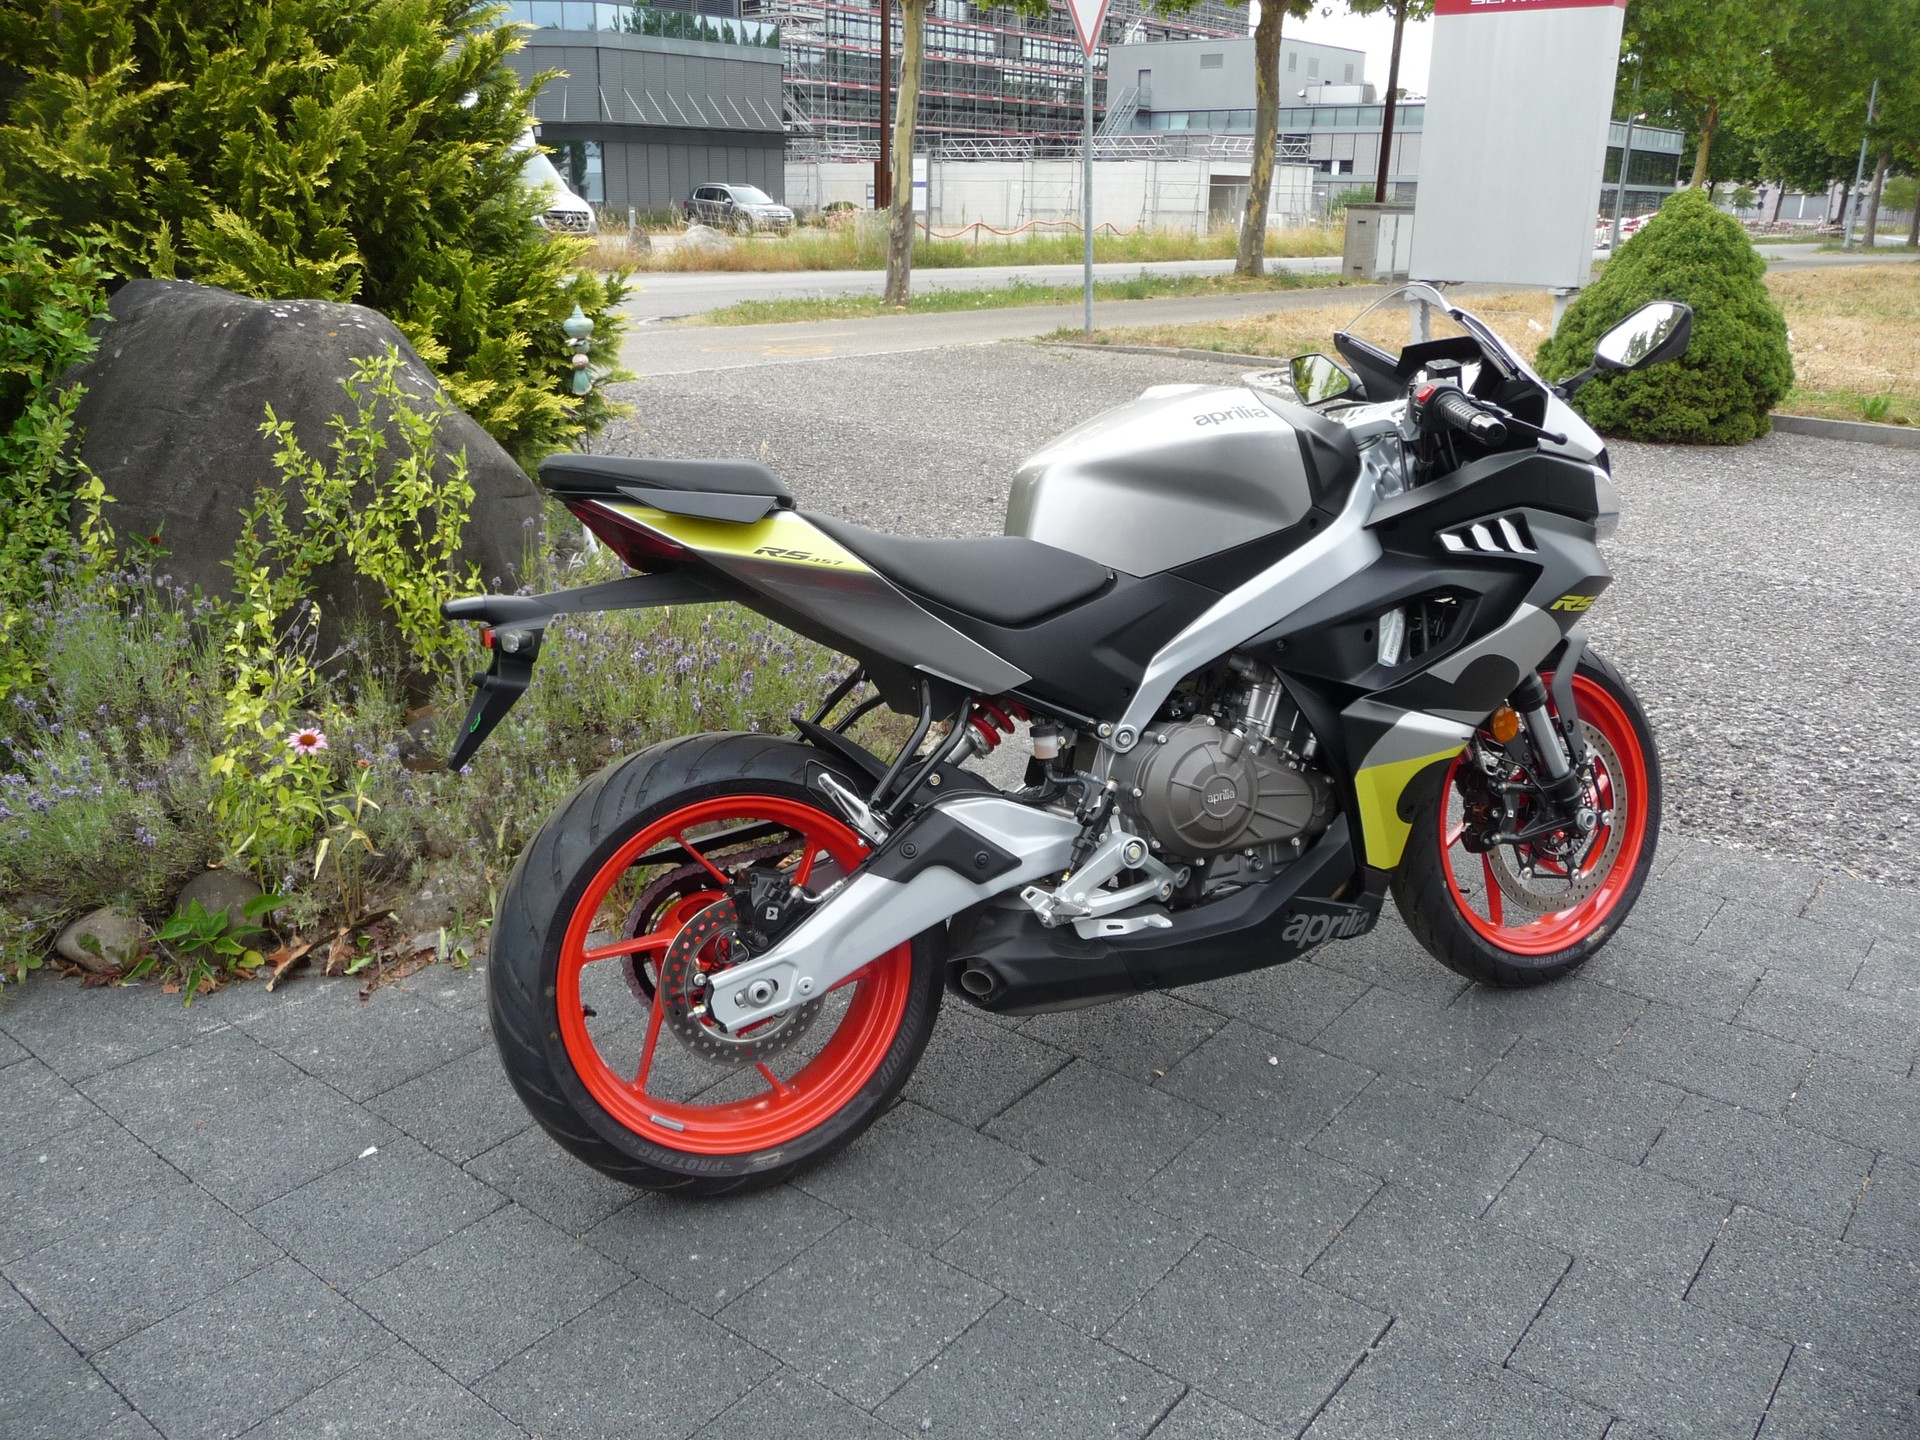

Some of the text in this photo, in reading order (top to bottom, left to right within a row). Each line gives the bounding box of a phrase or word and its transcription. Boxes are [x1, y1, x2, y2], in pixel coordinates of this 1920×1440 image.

[1193, 406, 1270, 426] aprilia
[753, 546, 813, 560] RS
[1549, 595, 1597, 611] RS
[1207, 789, 1235, 804] aprilia
[1282, 909, 1370, 949] aprilia
